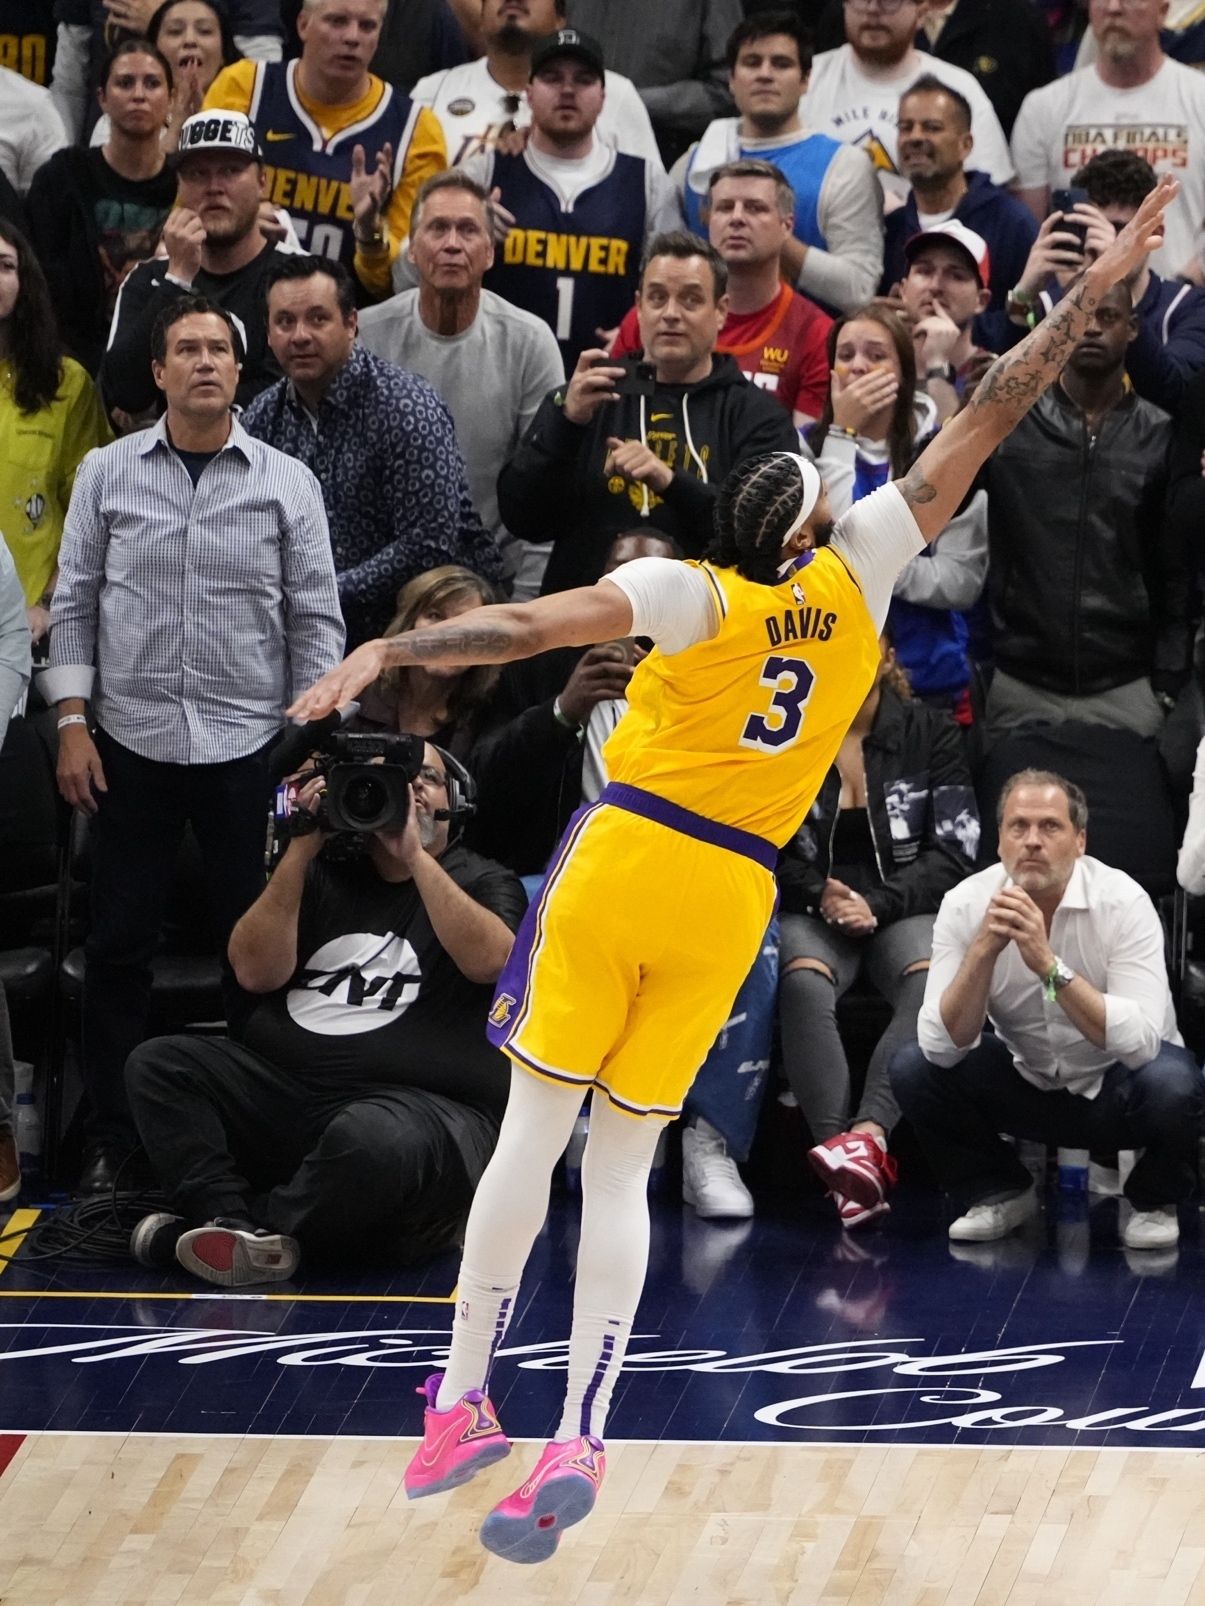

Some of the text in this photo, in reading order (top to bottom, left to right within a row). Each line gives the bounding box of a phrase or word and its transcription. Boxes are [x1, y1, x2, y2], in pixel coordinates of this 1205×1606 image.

[503, 227, 629, 276] DENVER
[556, 276, 575, 341] 1
[763, 346, 789, 362] WU
[765, 607, 838, 648] DAVIS
[737, 655, 818, 755] 3
